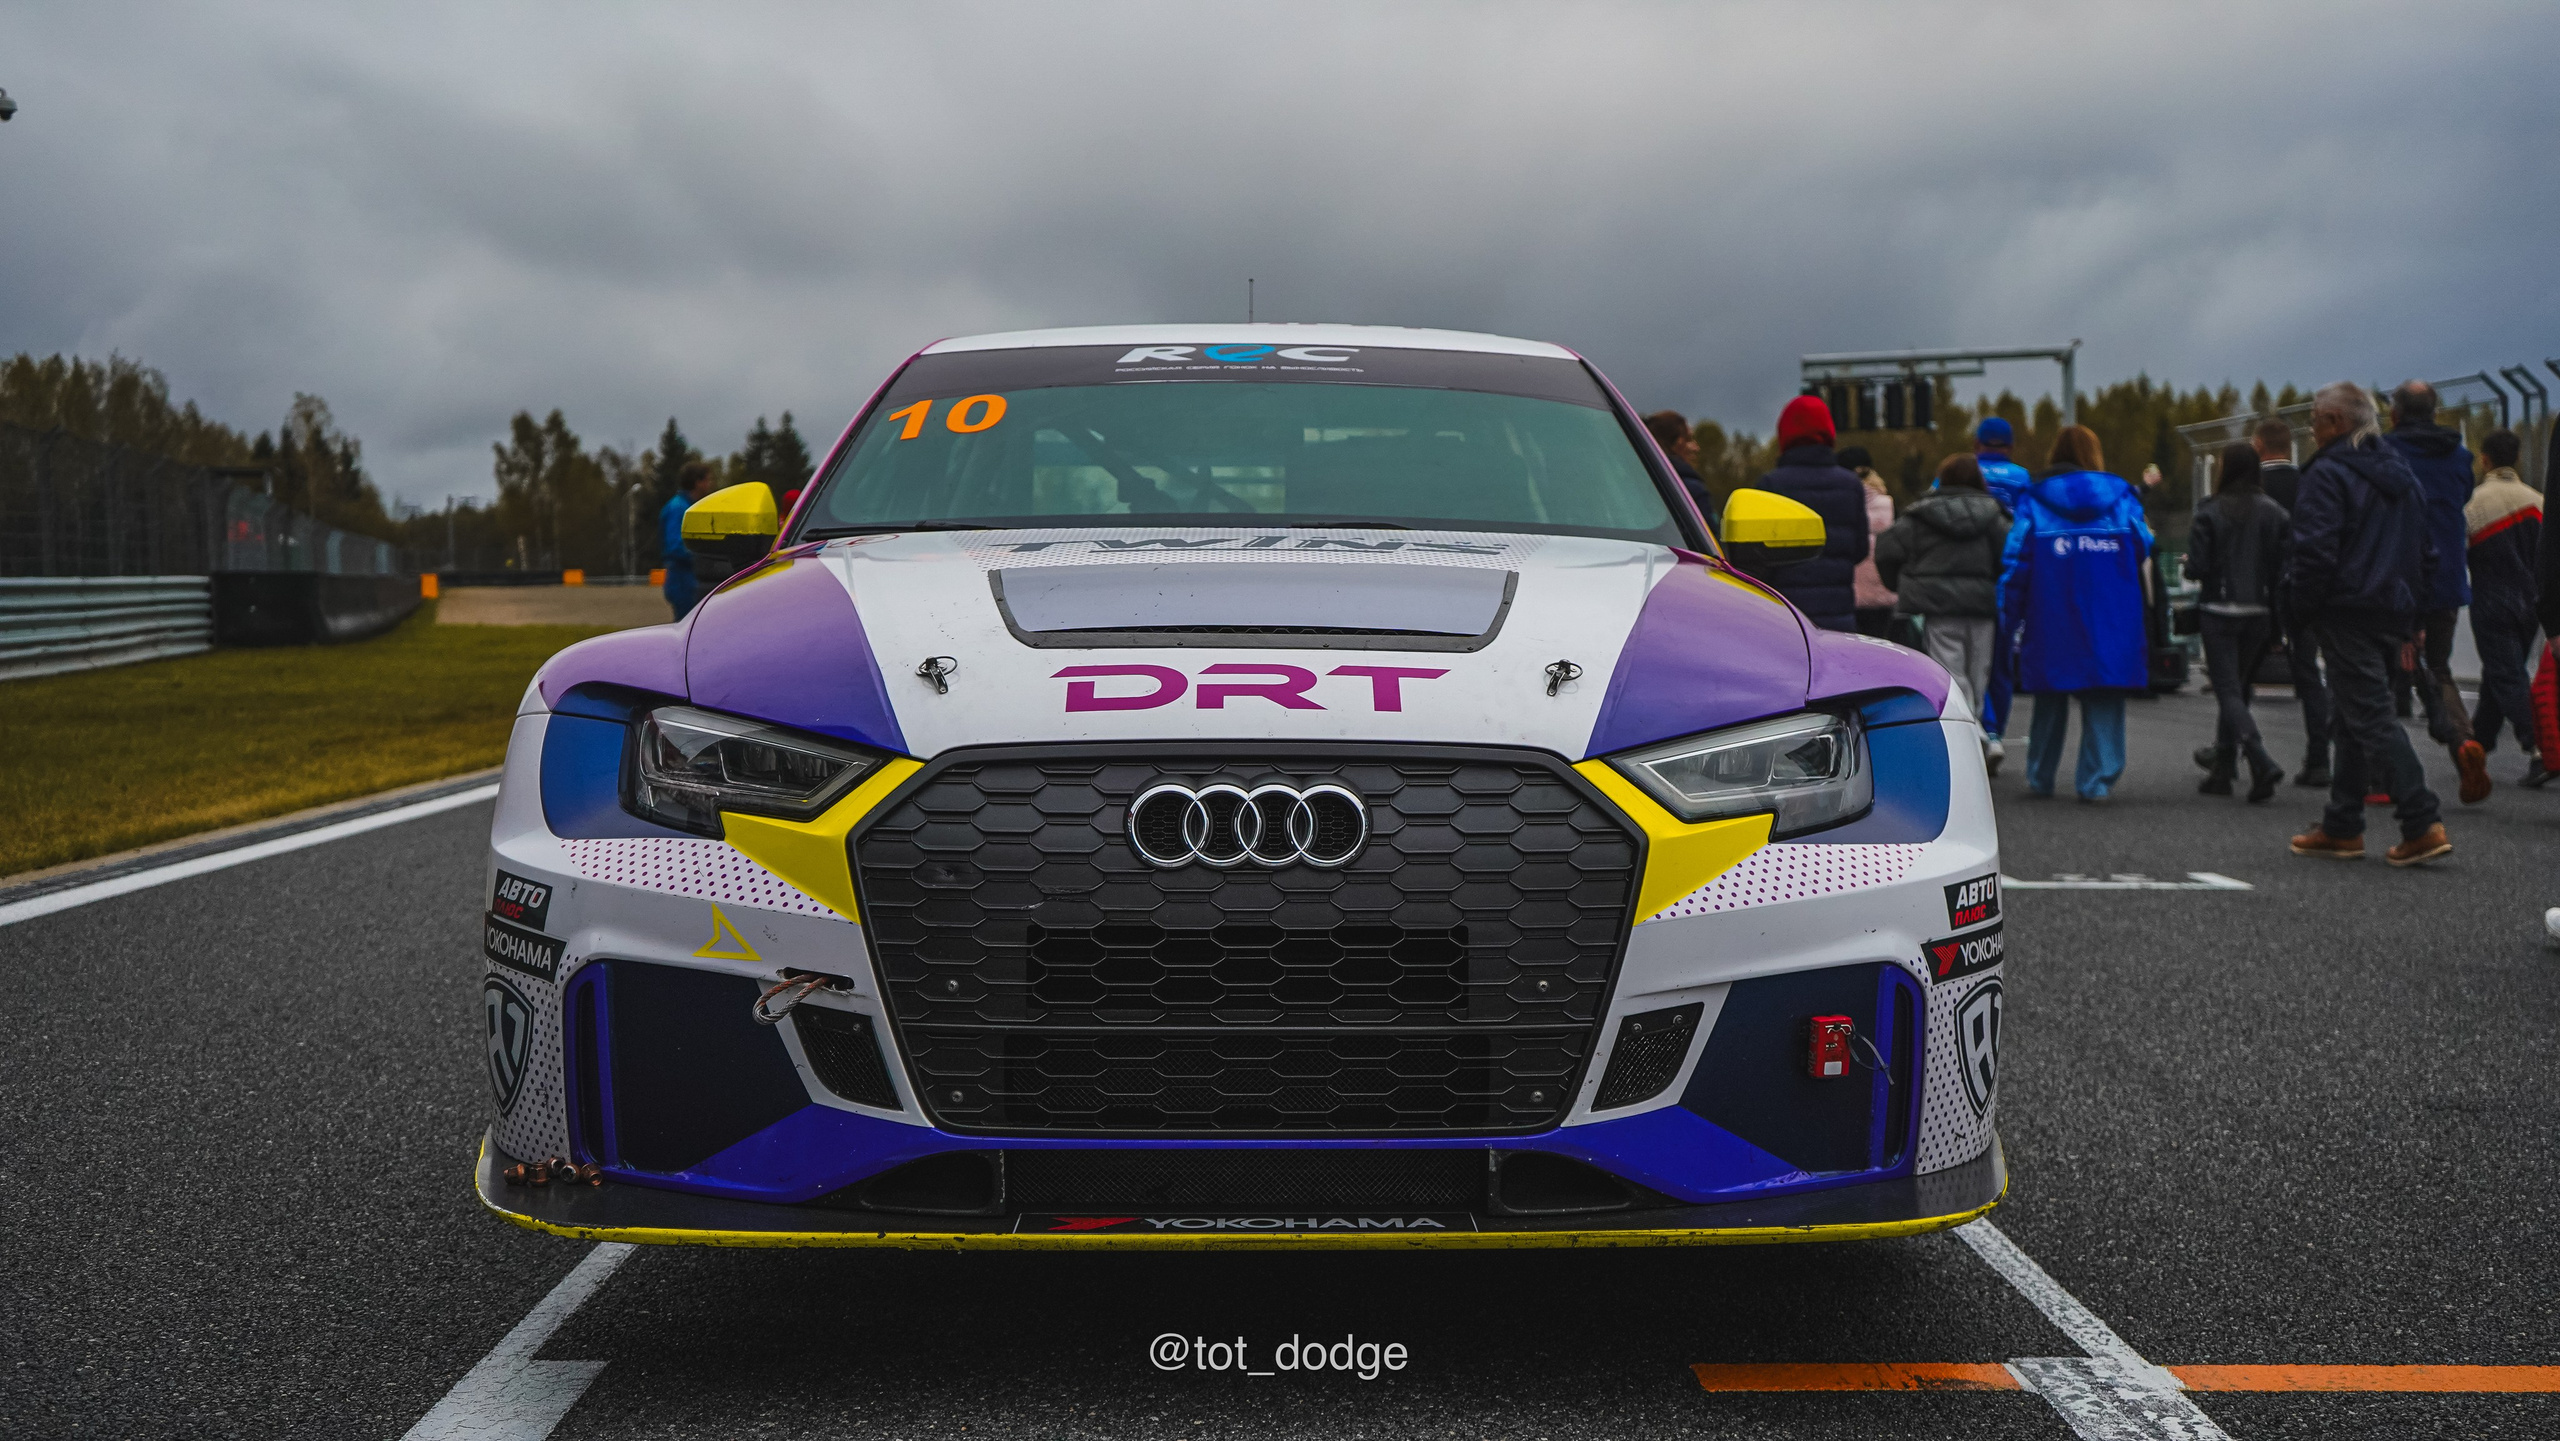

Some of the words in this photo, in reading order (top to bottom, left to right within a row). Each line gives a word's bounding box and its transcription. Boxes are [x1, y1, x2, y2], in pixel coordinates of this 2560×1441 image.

[889, 394, 1007, 441] 10
[988, 536, 1506, 555] TWINS
[1050, 663, 1451, 712] DRT
[498, 877, 546, 908] АВТО
[1956, 877, 1994, 909] АВТО
[493, 898, 524, 919] ПЛЮС
[1955, 904, 1986, 926] ПЛЮС
[1144, 1217, 1446, 1229] YOKOHAMA
